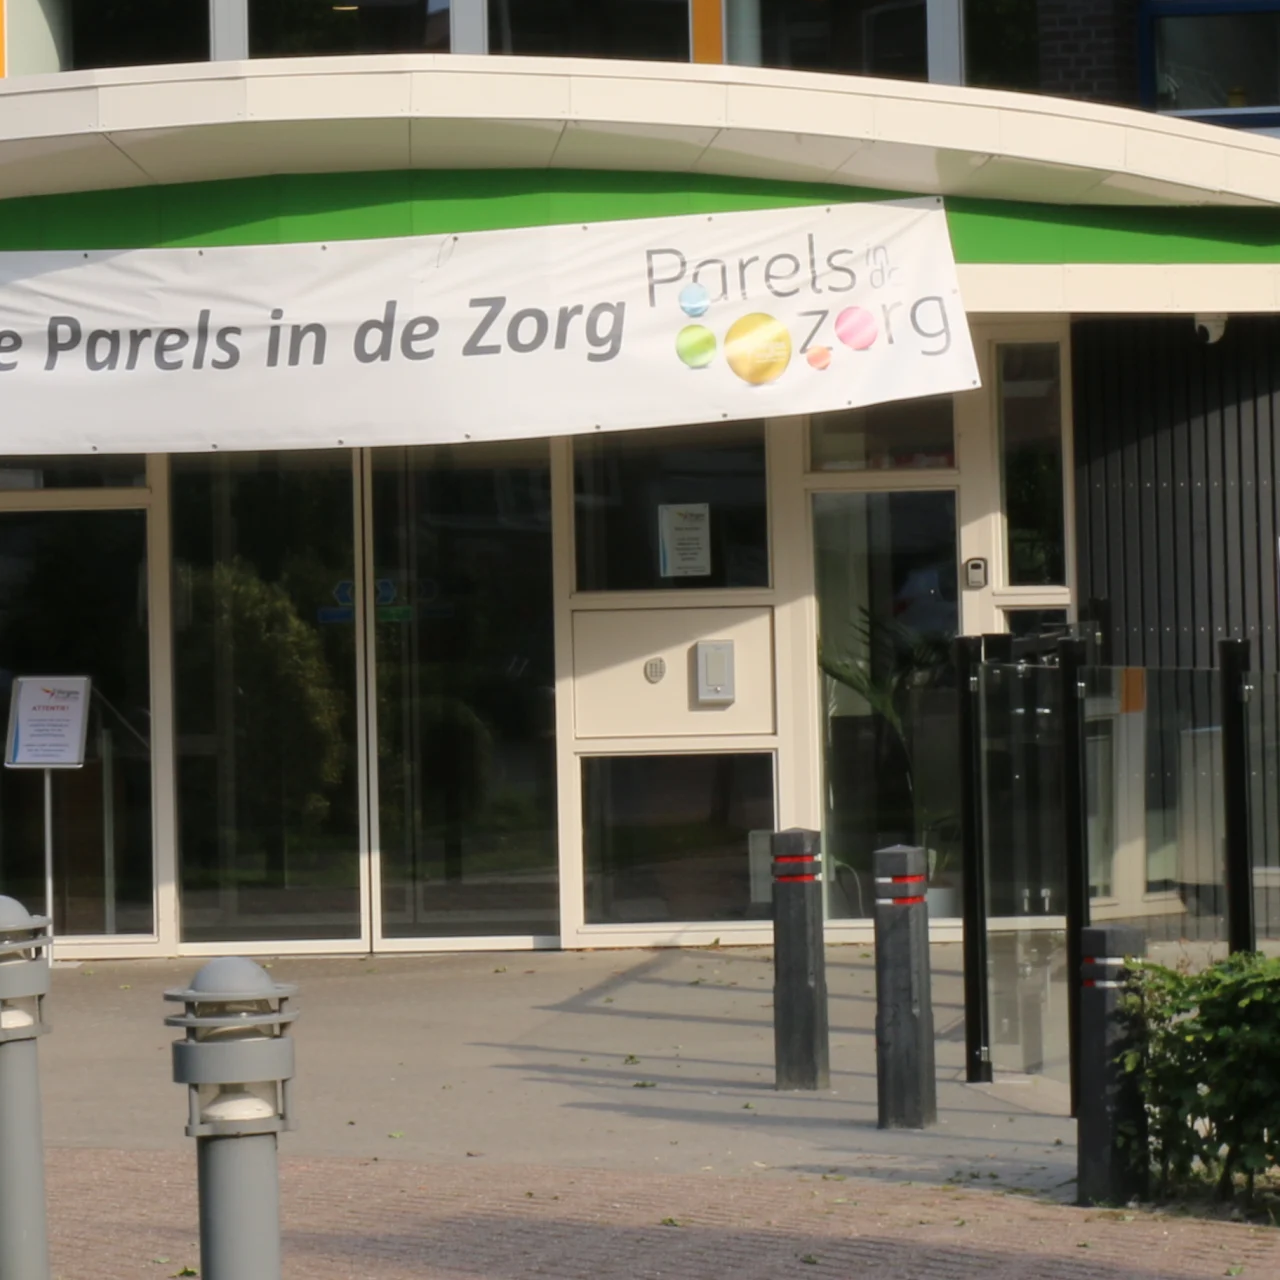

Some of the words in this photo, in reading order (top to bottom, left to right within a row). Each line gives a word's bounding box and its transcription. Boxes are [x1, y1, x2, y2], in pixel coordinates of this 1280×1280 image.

[645, 233, 858, 308] Parels
[45, 308, 243, 372] Parels
[266, 308, 328, 368] in
[353, 299, 440, 364] de
[461, 295, 626, 363] Zorg
